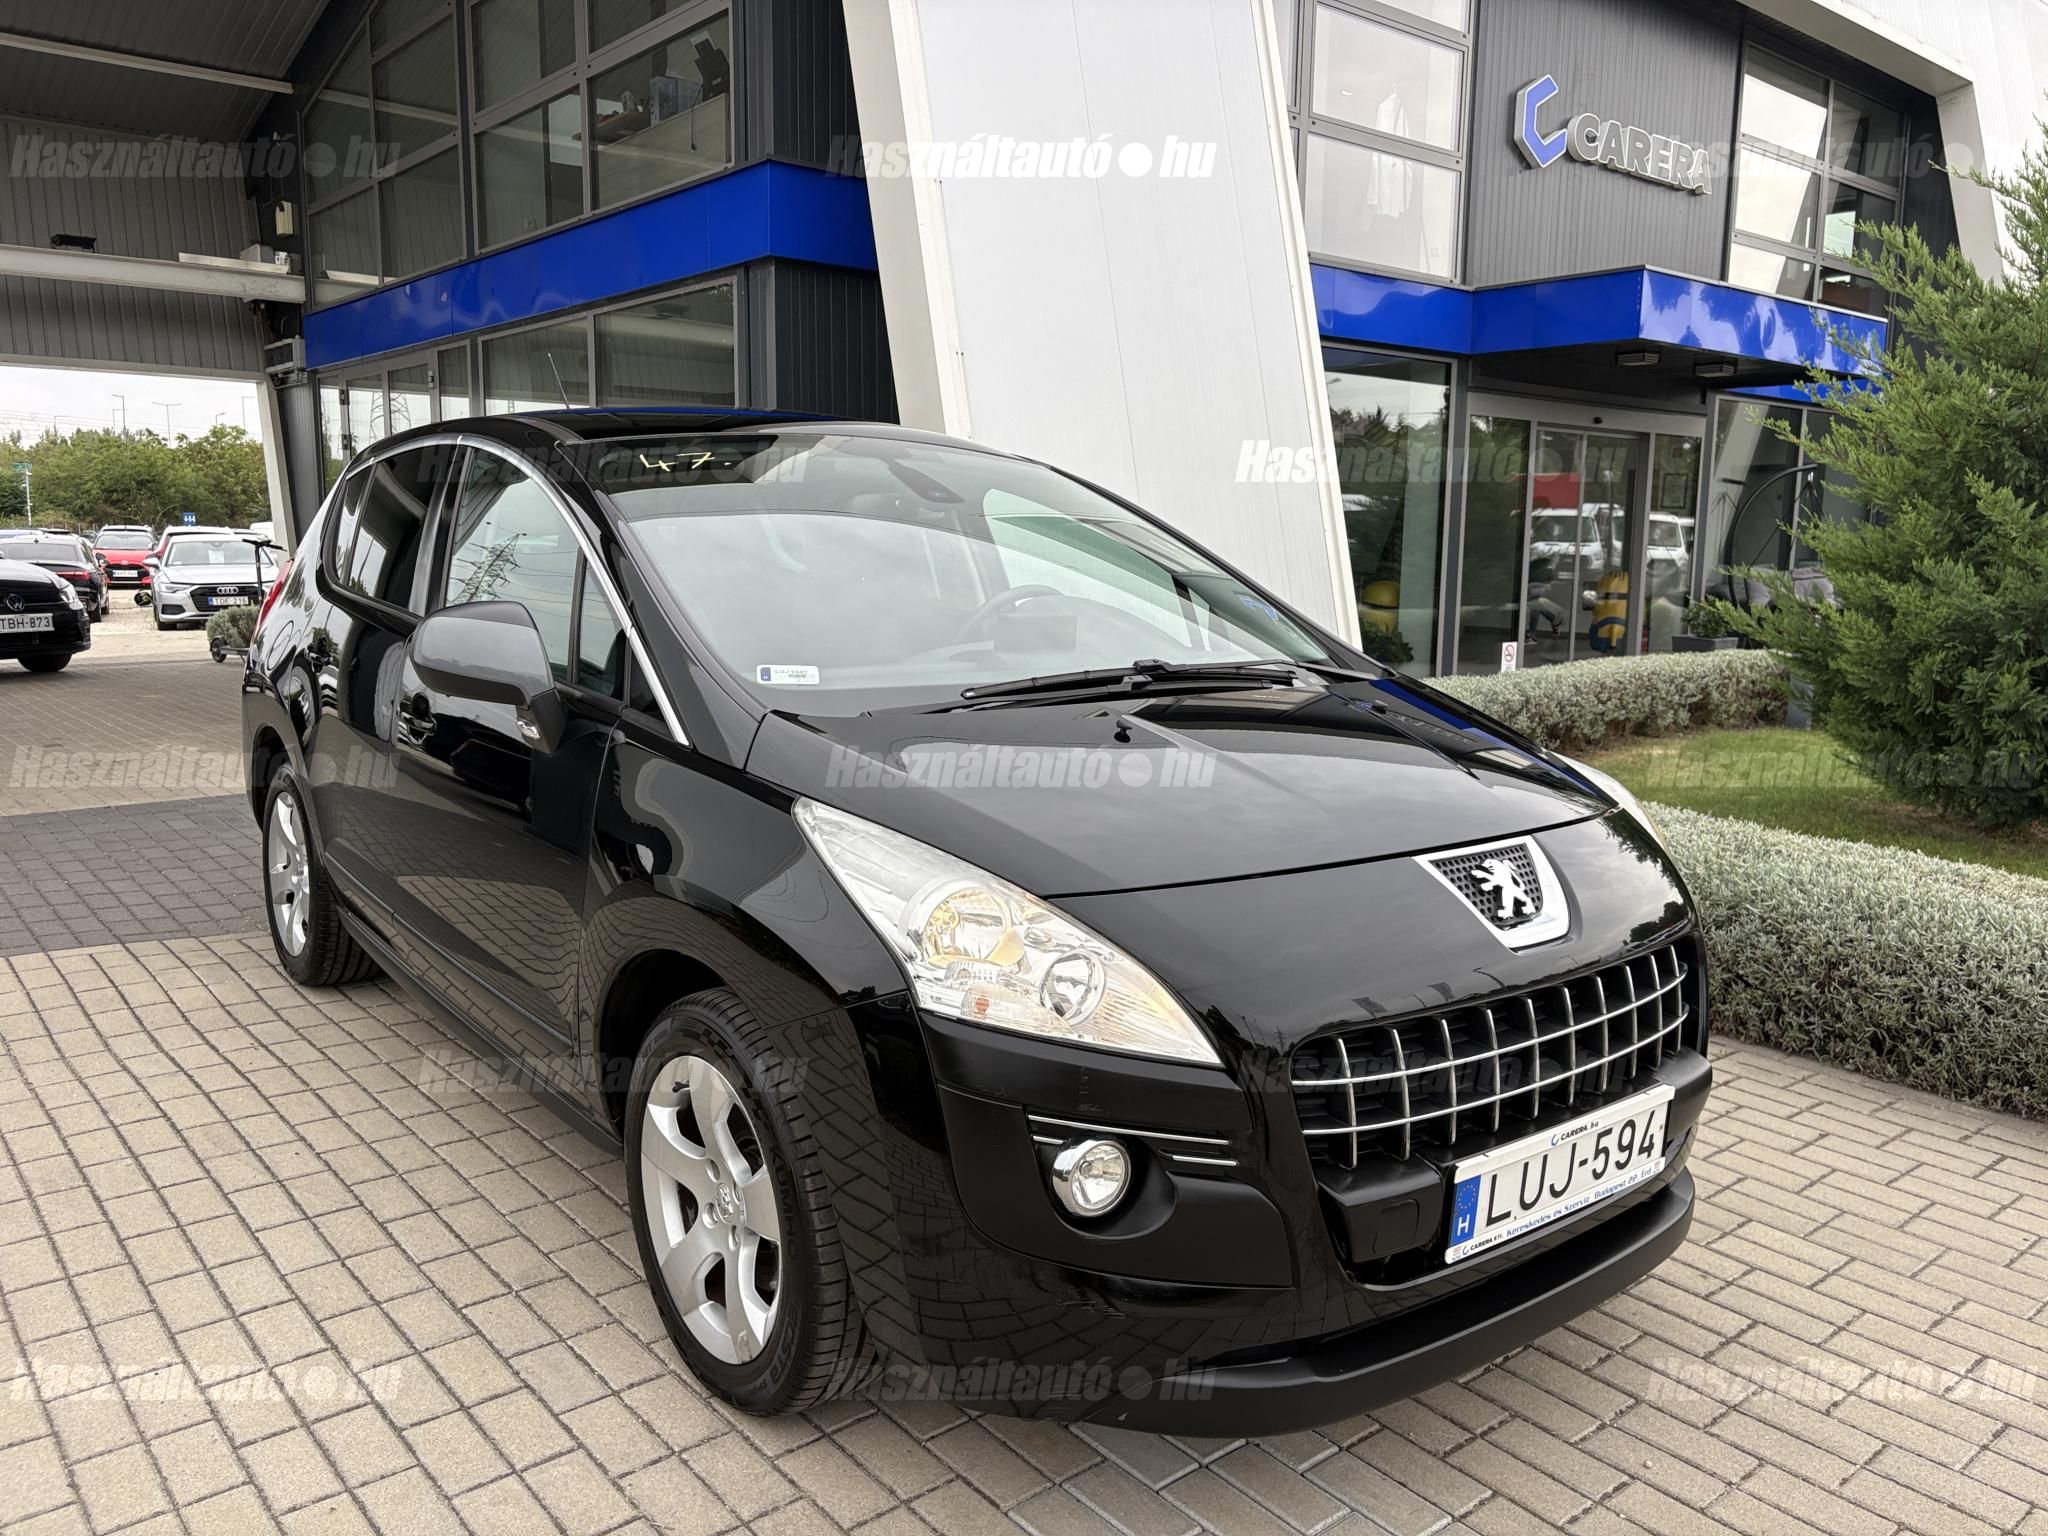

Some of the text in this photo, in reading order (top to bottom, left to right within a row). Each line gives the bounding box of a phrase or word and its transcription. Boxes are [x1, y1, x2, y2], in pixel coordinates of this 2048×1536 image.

[1567, 112, 1712, 196] CARERA
[0, 616, 51, 630] TBH-873
[1486, 1109, 1656, 1228] LUJ-594
[1457, 1213, 1471, 1237] H
